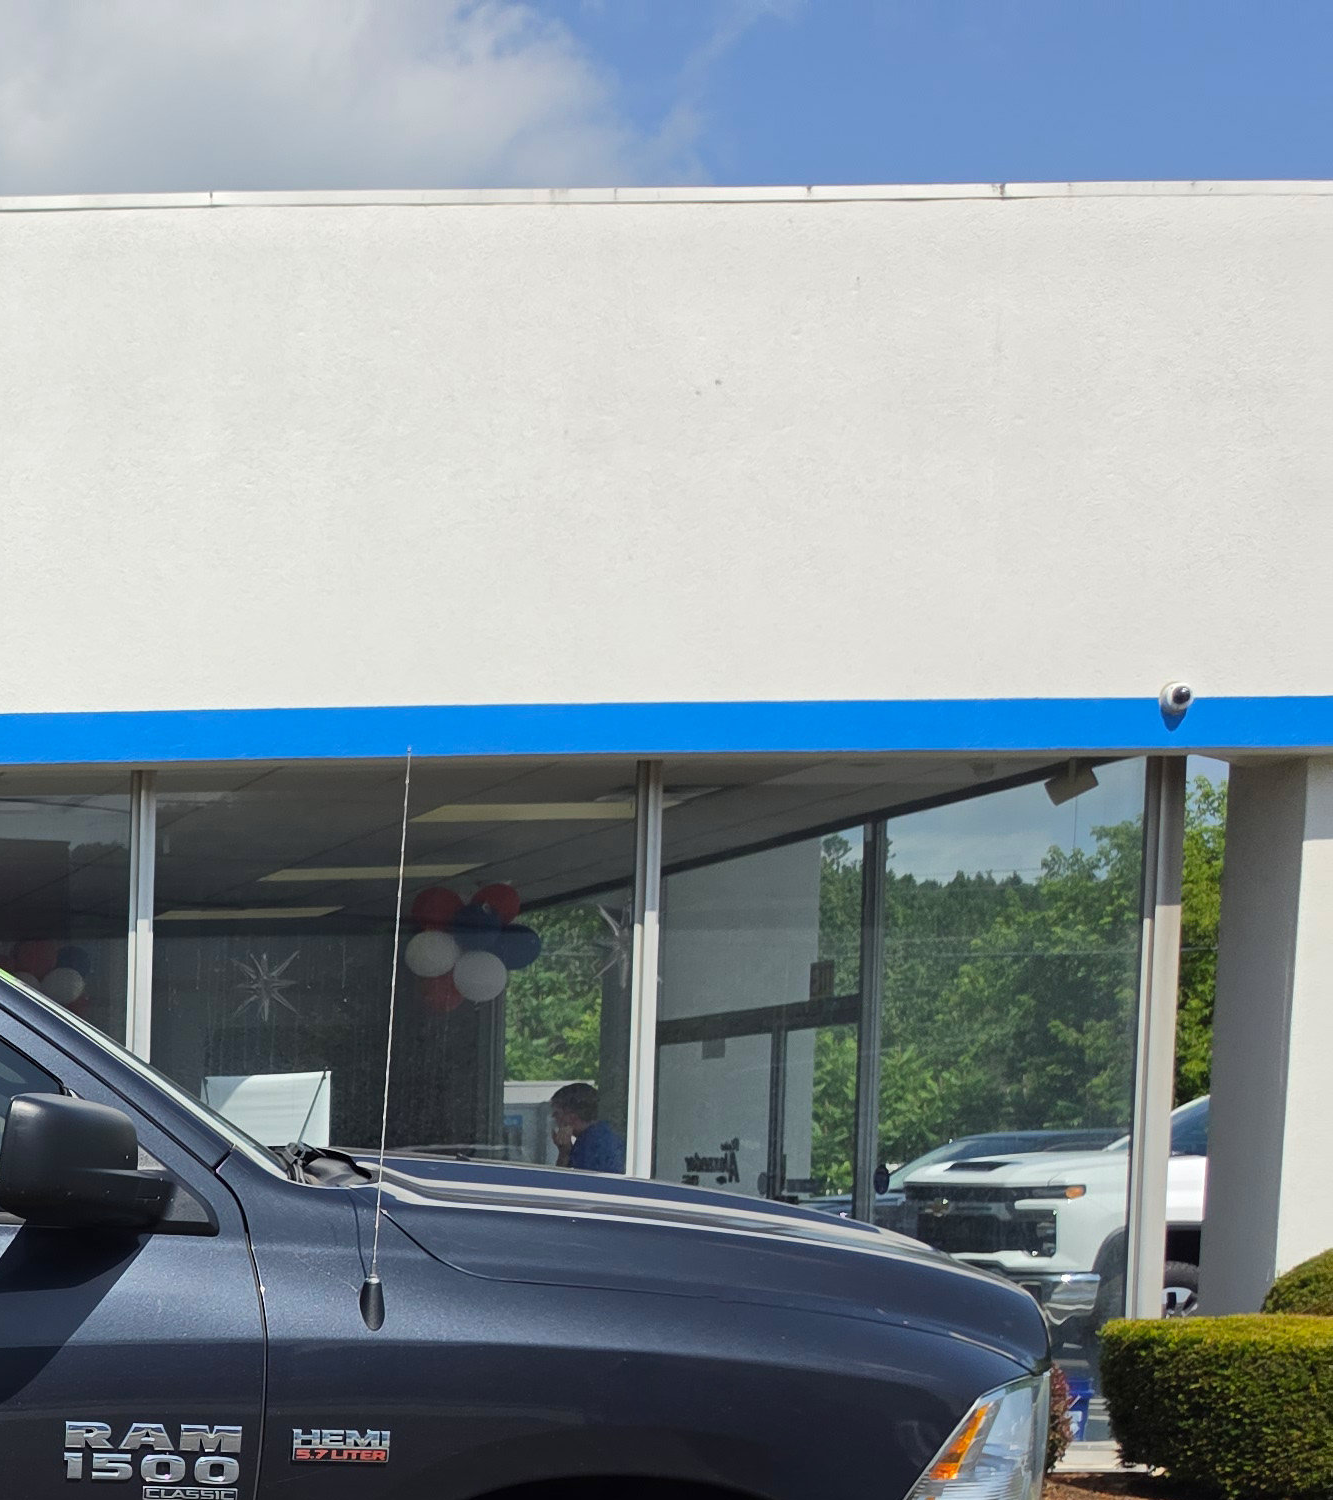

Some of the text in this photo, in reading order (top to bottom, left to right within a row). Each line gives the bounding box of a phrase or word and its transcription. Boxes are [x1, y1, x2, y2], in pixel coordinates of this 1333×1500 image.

[64, 1420, 242, 1453] RAM
[292, 1428, 391, 1448] HEMI
[296, 1449, 386, 1461] 5.7 LITER
[63, 1452, 241, 1485] 1500
[144, 1487, 236, 1500] CLASSIC
